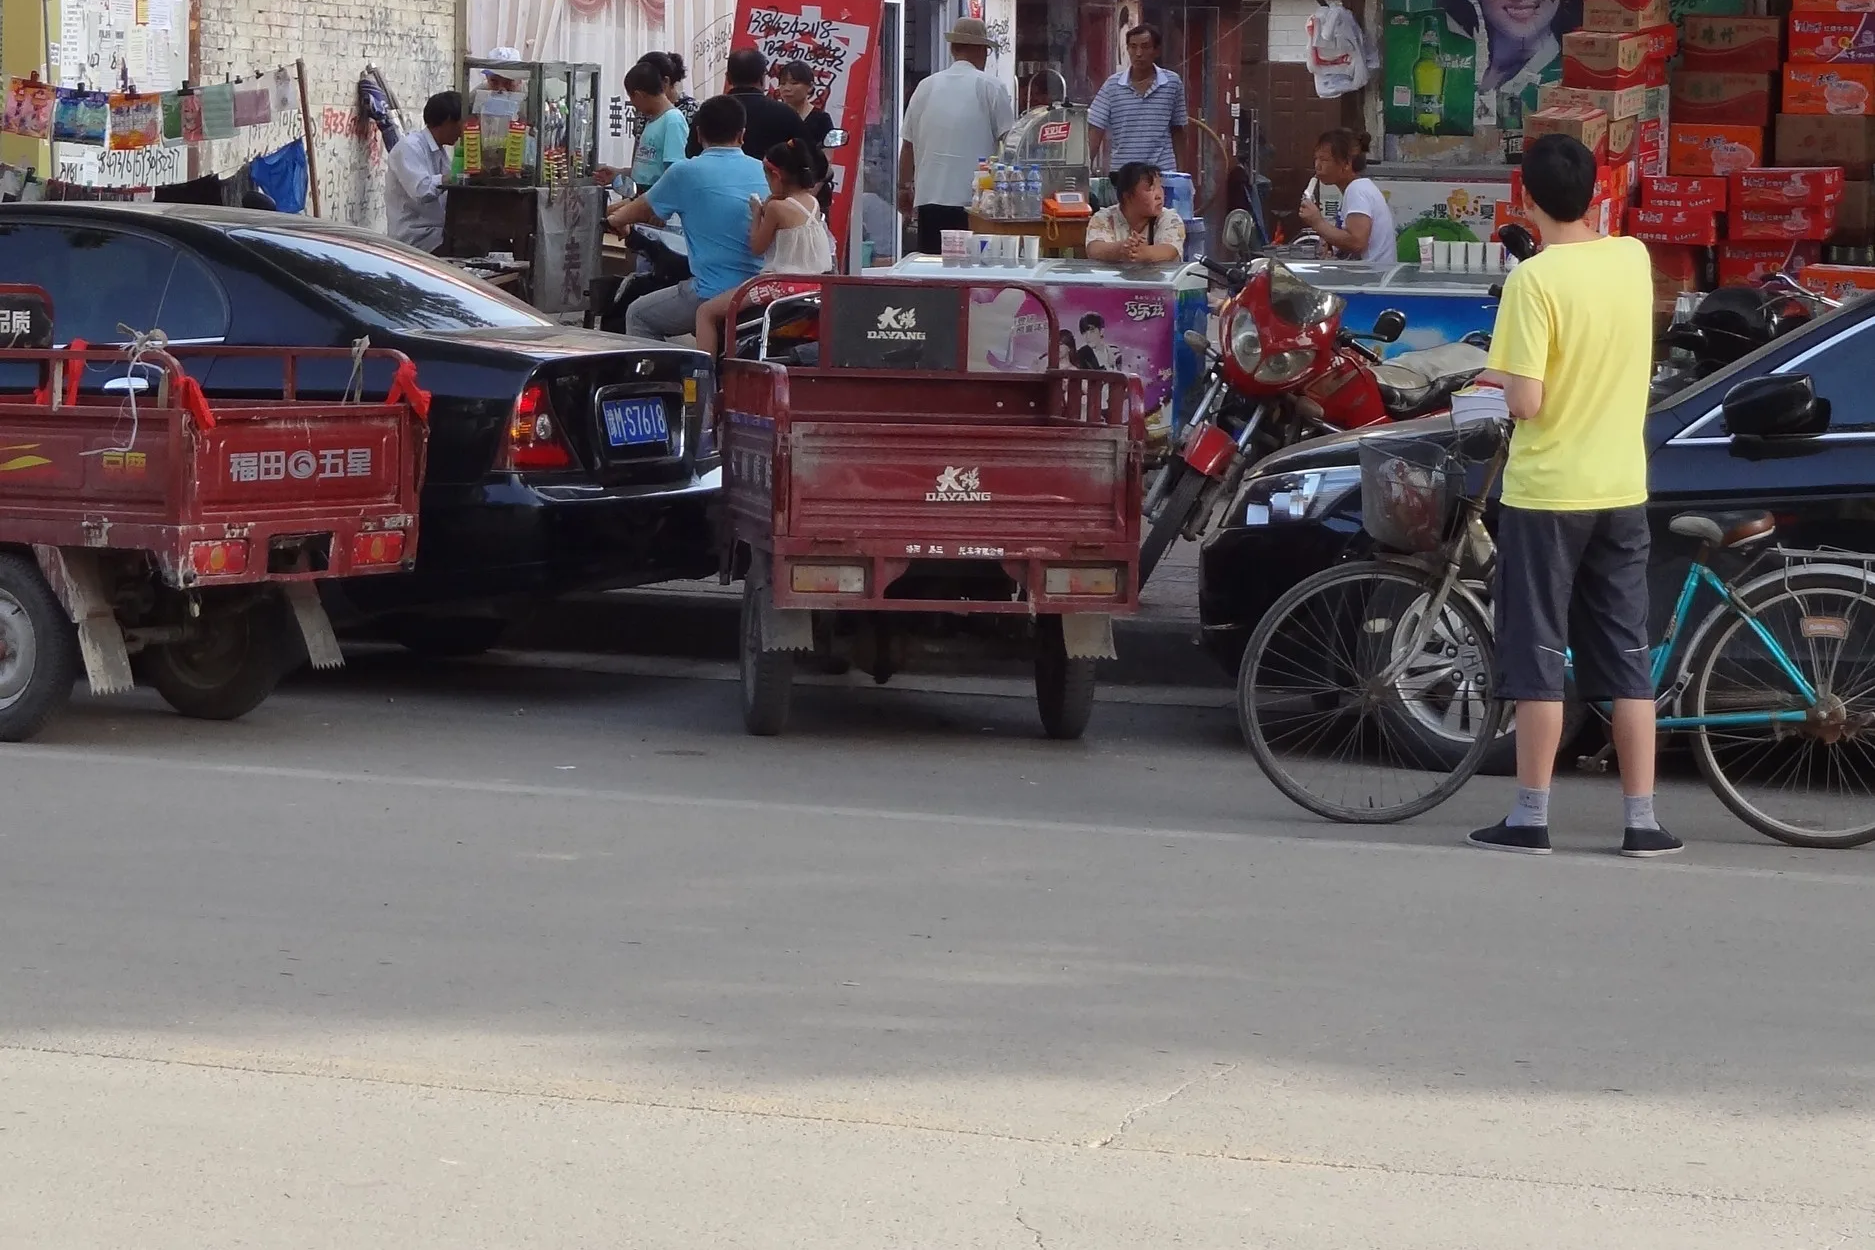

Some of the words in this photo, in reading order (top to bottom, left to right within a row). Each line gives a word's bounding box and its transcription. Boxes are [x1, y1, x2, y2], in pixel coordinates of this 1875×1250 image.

[867, 330, 926, 340] DAYANG
[230, 451, 286, 483] 福田
[318, 448, 372, 479] 五星
[925, 492, 992, 502] DAYANG
